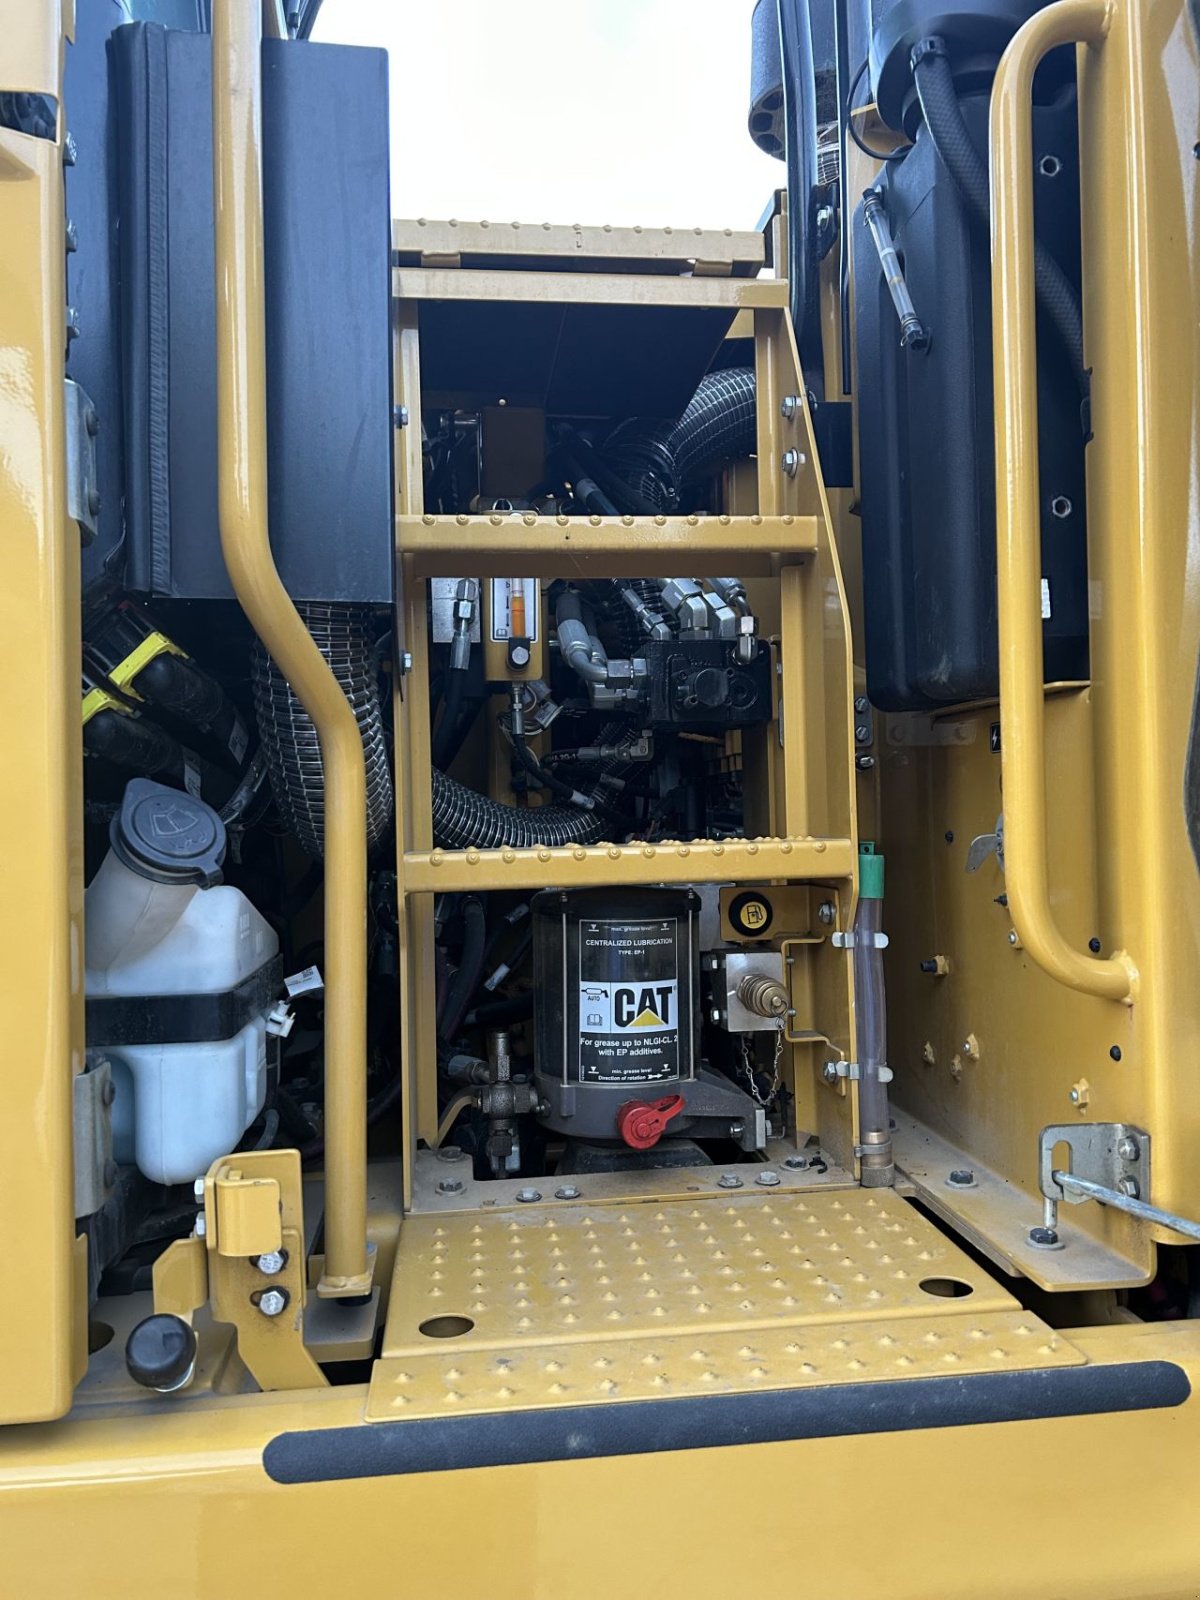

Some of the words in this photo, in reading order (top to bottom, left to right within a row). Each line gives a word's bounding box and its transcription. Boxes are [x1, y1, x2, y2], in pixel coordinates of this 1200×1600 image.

[585, 939, 632, 947] CENTRALIZED
[633, 938, 673, 947] LUBRICATION
[614, 986, 673, 1028] CAT
[580, 1037, 593, 1046] For
[594, 1039, 620, 1048] grease
[621, 1040, 632, 1048] up
[598, 1048, 615, 1056] with
[616, 1048, 628, 1056] EP
[629, 1047, 663, 1056] additives.
